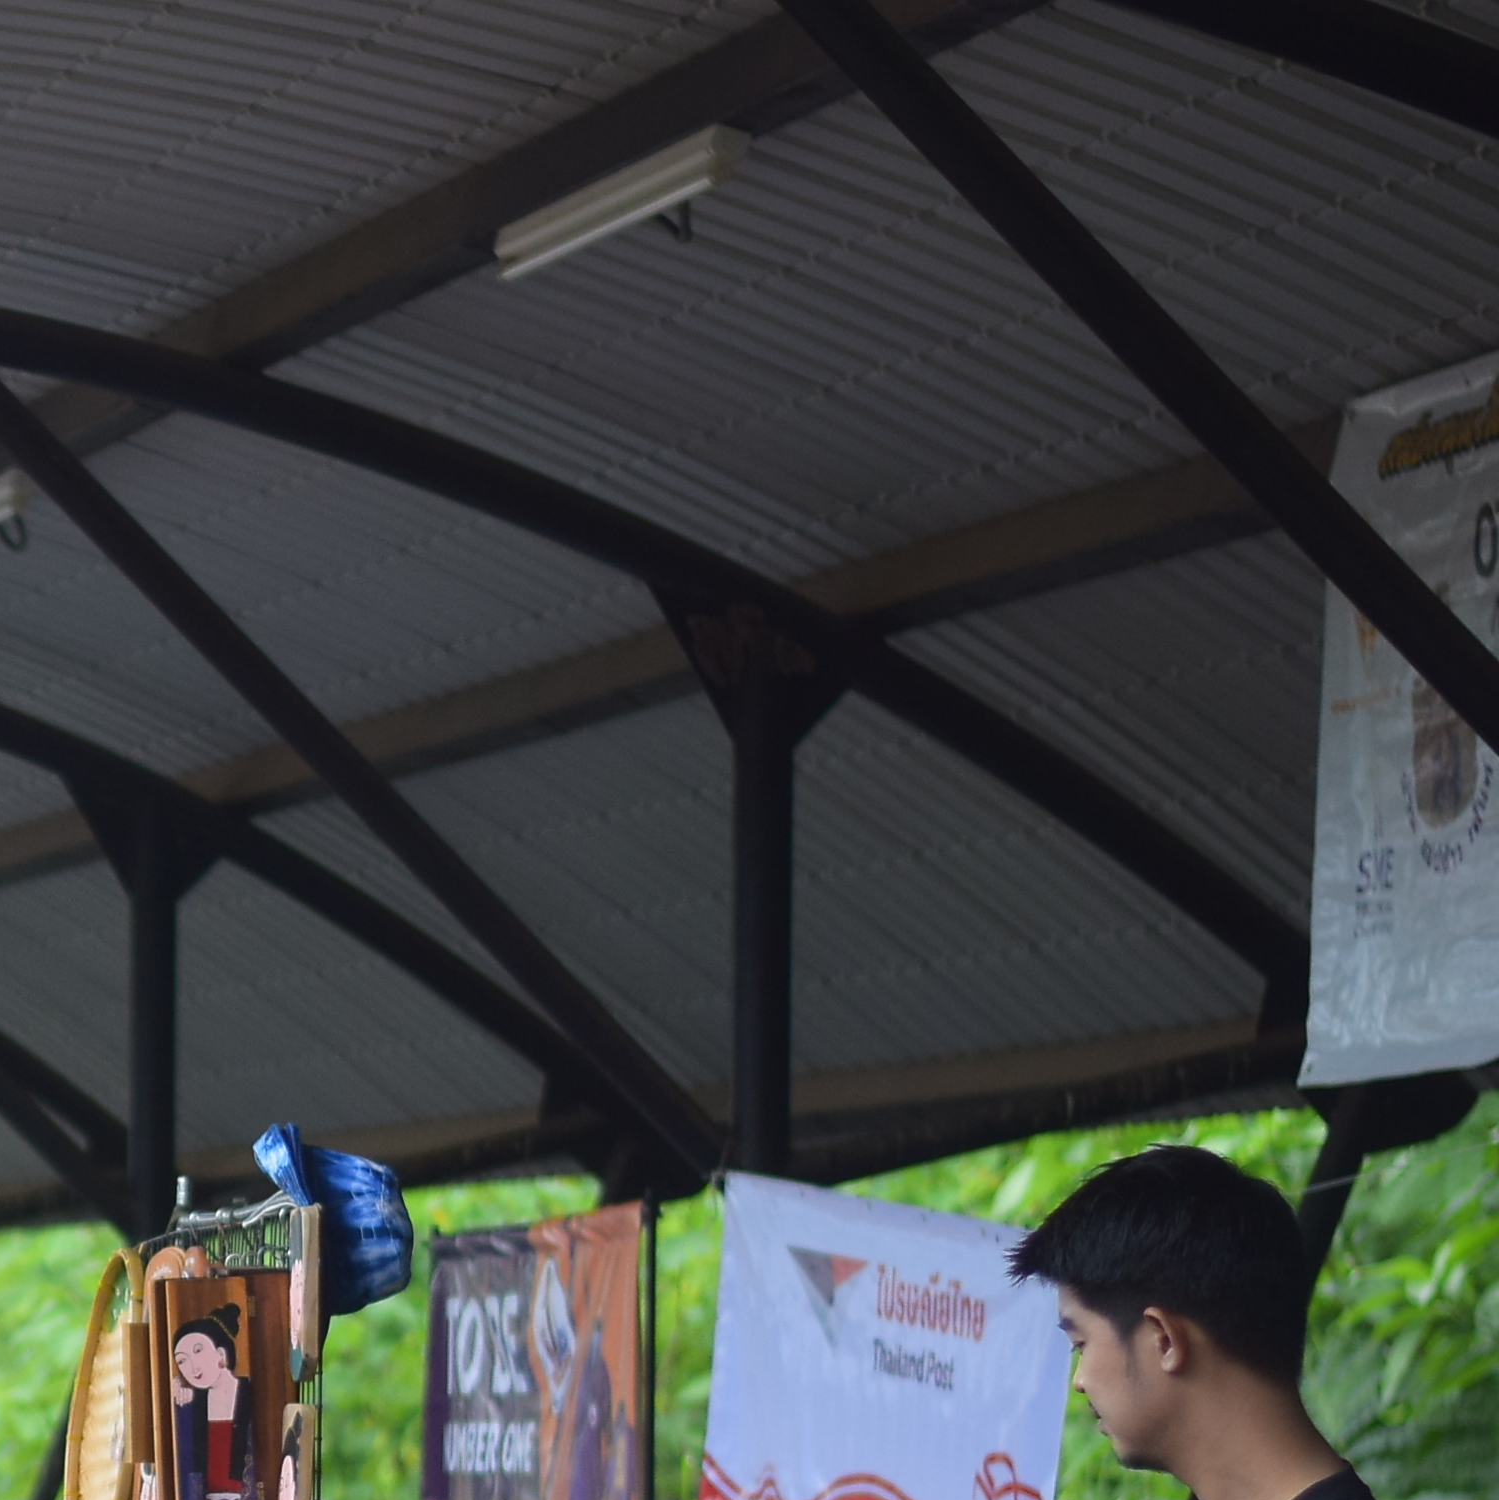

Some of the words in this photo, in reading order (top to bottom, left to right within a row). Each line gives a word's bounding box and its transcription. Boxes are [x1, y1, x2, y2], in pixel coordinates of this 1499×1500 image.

[446, 1296, 484, 1394] TO
[873, 1338, 925, 1383] Thailand
[925, 1350, 953, 1391] Post
[443, 1420, 502, 1474] UMBER
[501, 1420, 536, 1474] ONE
